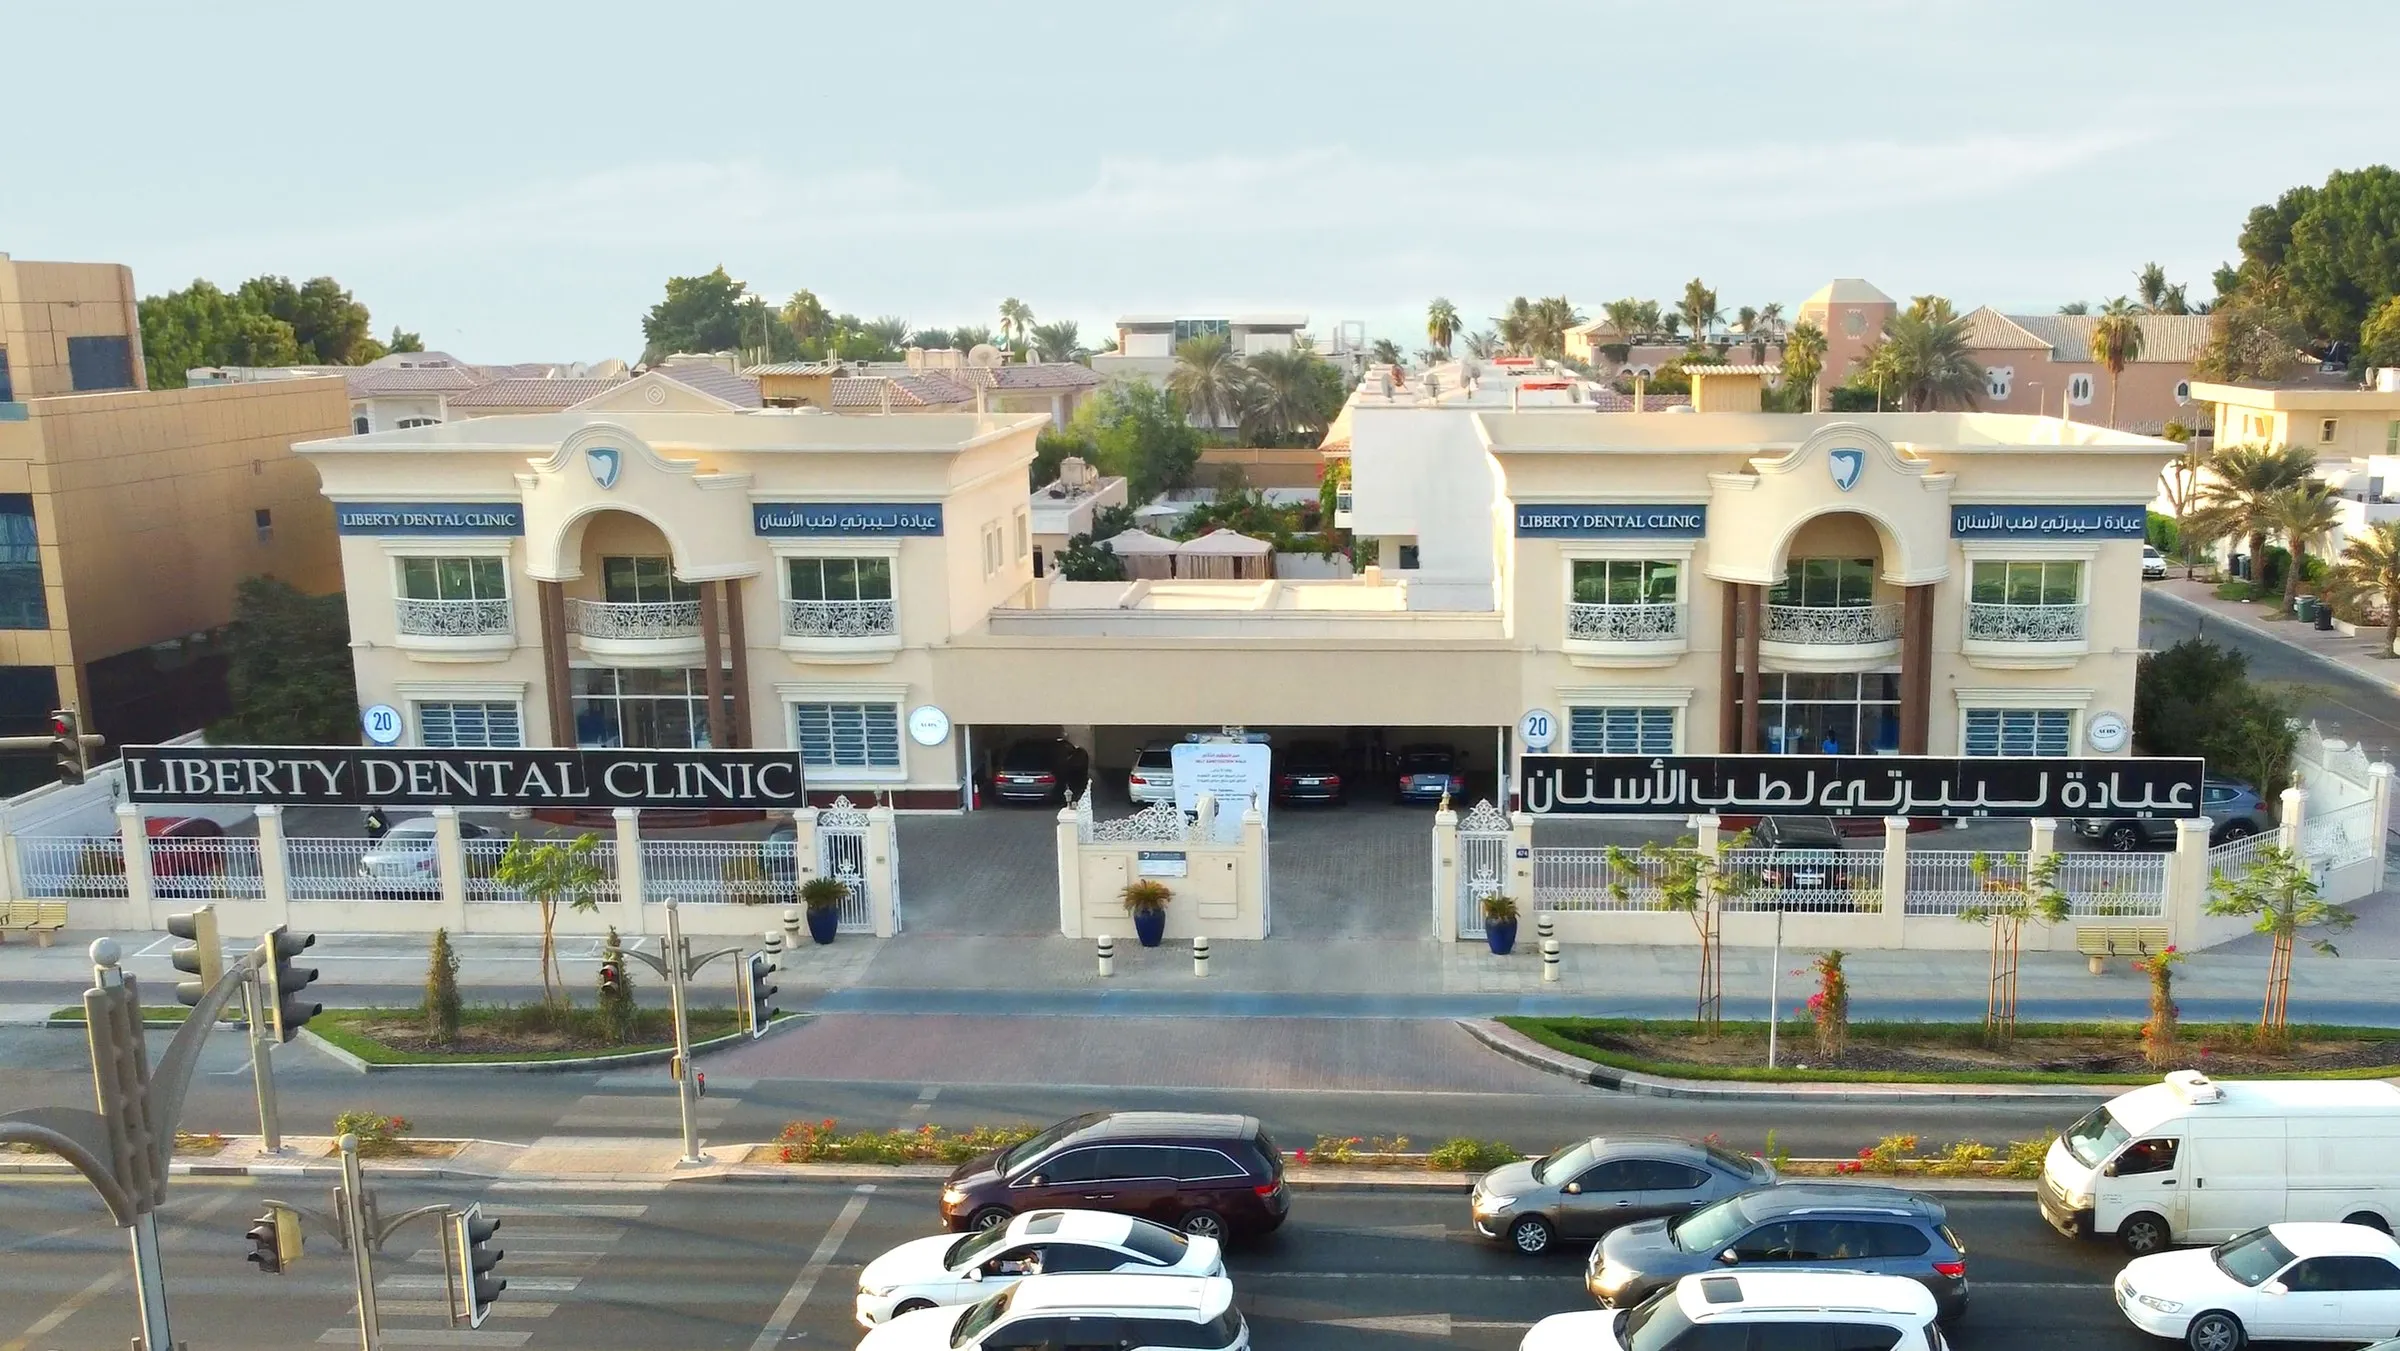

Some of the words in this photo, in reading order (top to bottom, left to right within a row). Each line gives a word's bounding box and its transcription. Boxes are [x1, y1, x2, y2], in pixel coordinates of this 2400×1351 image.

[342, 513, 401, 526] LIBERTY
[403, 513, 464, 527] DENTAL
[465, 513, 516, 527] CLINIC
[760, 510, 803, 531] الأسنان
[806, 514, 836, 531] لطب
[900, 514, 936, 531] عيادة
[1519, 515, 1581, 528] LIBERTY
[1583, 515, 1645, 528] DENTAL
[1648, 515, 1700, 528] CLINIC
[1957, 511, 2003, 532] الأسنان
[2006, 515, 2037, 532] لطب
[2104, 515, 2141, 532] عيادة
[373, 711, 392, 731] 20
[1528, 716, 1547, 736] 20
[127, 758, 347, 795] LIBERTY
[360, 760, 590, 798] DENTAL
[603, 762, 795, 799] CLINIC
[1527, 758, 1686, 813] الأسنان
[1691, 770, 1815, 814] لطب
[2061, 771, 2194, 817] عيادة
